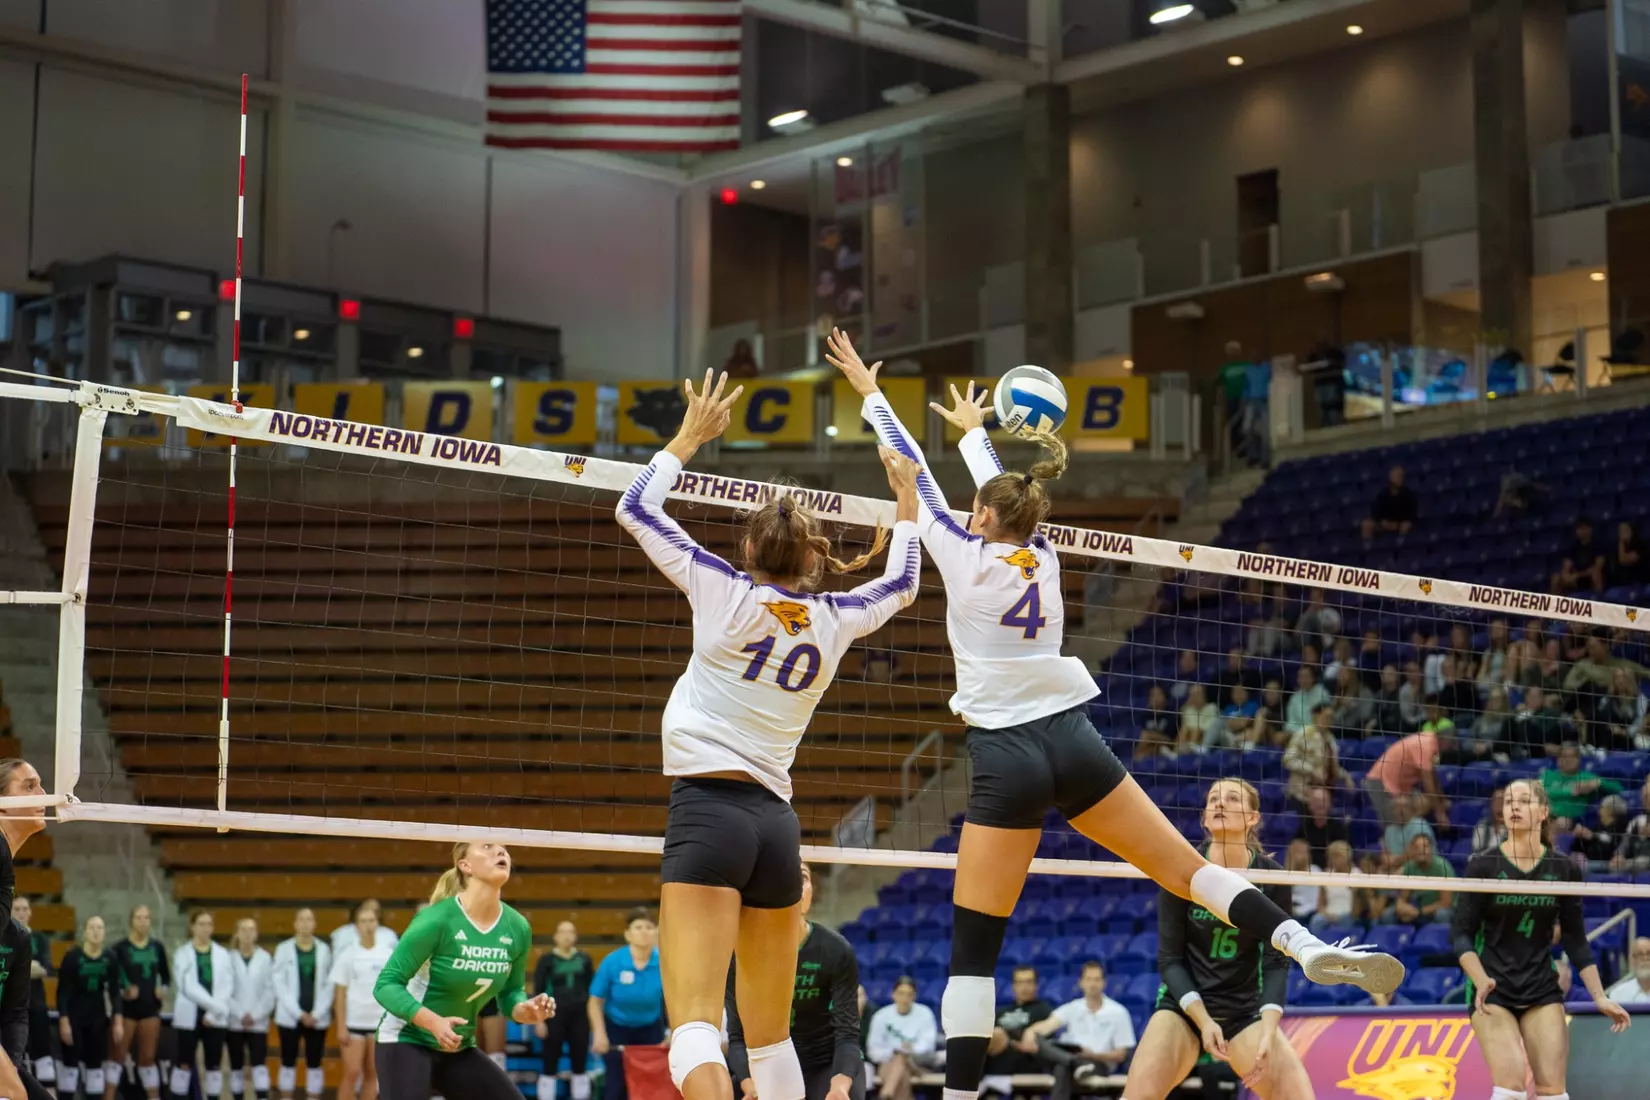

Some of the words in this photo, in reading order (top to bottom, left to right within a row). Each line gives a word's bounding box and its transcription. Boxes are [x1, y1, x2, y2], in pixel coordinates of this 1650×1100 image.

[268, 411, 424, 456] NORTHERN
[430, 438, 501, 466] IOWA
[564, 455, 587, 466] UNI
[1082, 532, 1133, 555] IOWA
[1236, 553, 1333, 582] NORTHERN
[1336, 568, 1380, 589] IOWA
[999, 581, 1046, 640] 4
[1468, 586, 1550, 612] NORTHERN
[1554, 598, 1593, 618] IOWA
[739, 634, 823, 693] 10
[1496, 894, 1556, 906] DAKOTA
[1516, 910, 1535, 938] 4
[461, 944, 508, 960] NORTH
[1209, 927, 1240, 959] 16
[452, 958, 511, 974] DAKOTA
[465, 977, 494, 1003] 7
[1347, 1018, 1475, 1082] UNI
